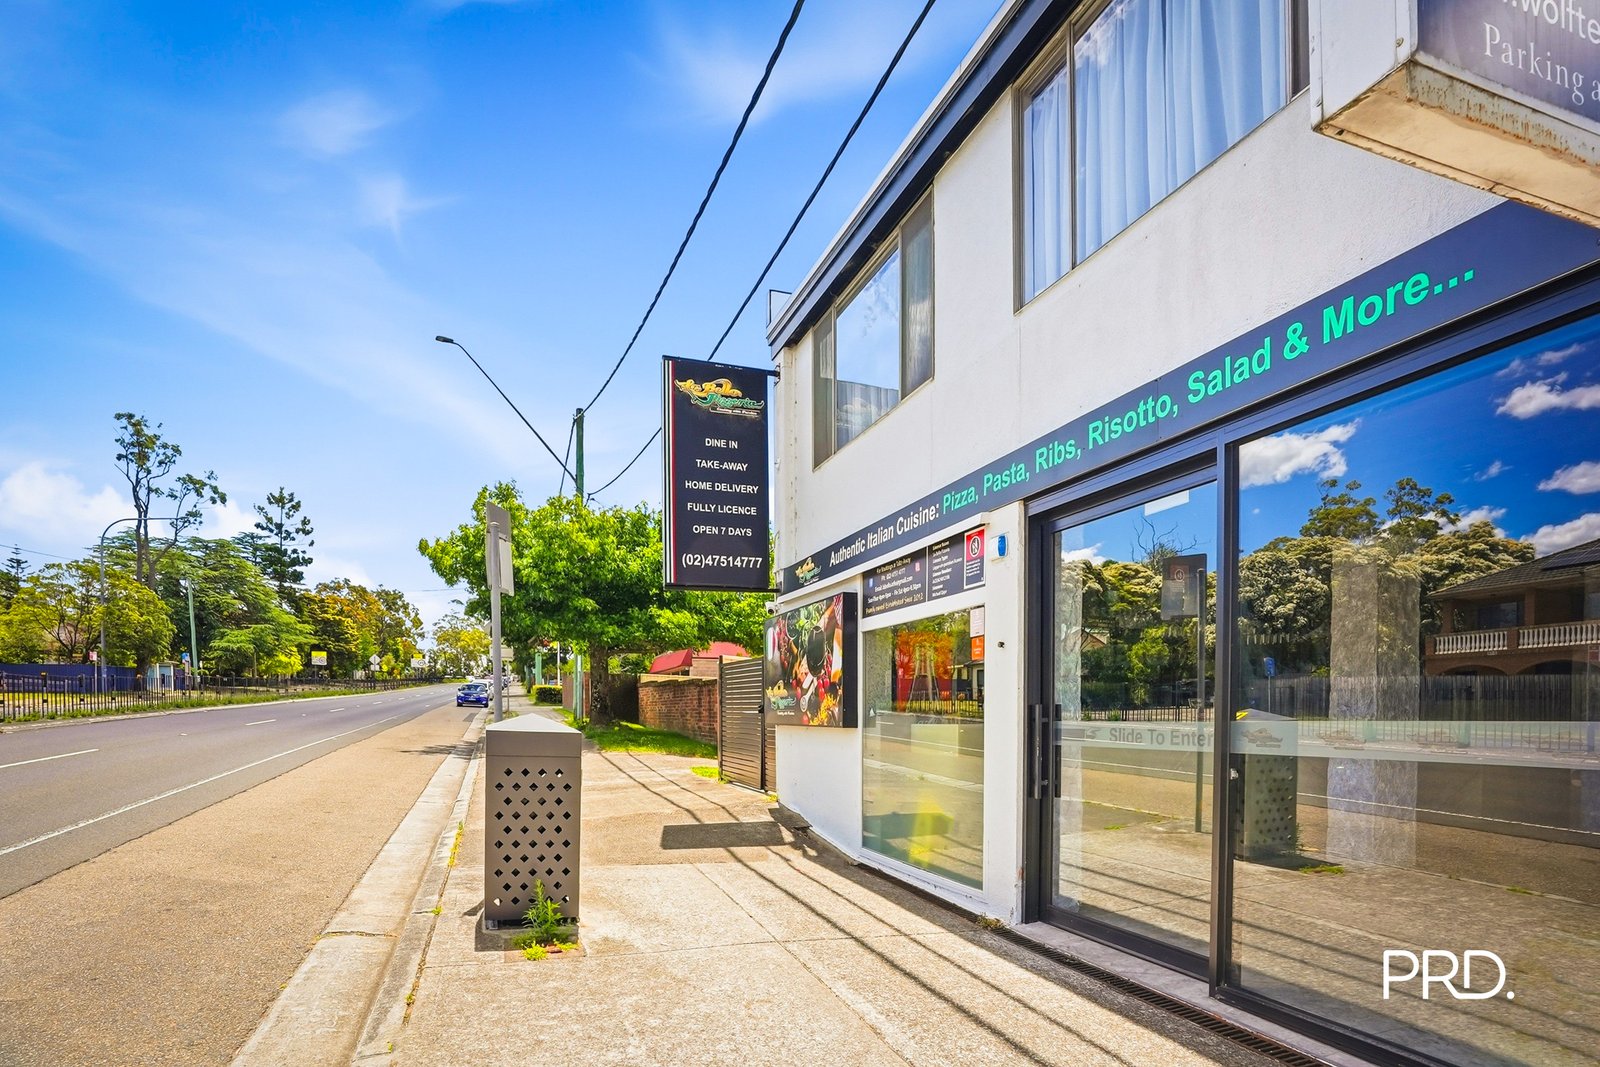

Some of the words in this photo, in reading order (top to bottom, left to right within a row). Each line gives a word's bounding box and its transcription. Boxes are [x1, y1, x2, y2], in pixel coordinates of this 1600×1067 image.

[1484, 22, 1584, 105] Parking
[829, 538, 865, 567] Authentic
[867, 525, 894, 549] Italian
[896, 503, 939, 535] Cuisine:
[943, 486, 979, 514] Pizza,
[983, 462, 1030, 497] Pasta,
[1035, 436, 1081, 473] Ribs,
[1088, 393, 1178, 450] Risotto,
[1187, 336, 1271, 403] Salad
[1283, 322, 1310, 360] &
[1322, 269, 1475, 345] More...
[705, 438, 727, 448] DINE
[729, 440, 738, 449] IN
[696, 459, 748, 471] TAKE-AWAY
[685, 480, 713, 491] HOME
[715, 482, 759, 494] DELIVERY
[687, 503, 716, 513] FULLY
[718, 504, 757, 515] LICENCE
[692, 525, 719, 535] OPEN
[721, 527, 726, 535] 7
[728, 528, 752, 537] DAYS
[682, 553, 762, 569] (02)47514777
[1109, 727, 1143, 744] Slide
[1149, 729, 1165, 745] To
[1170, 729, 1214, 748] Enter
